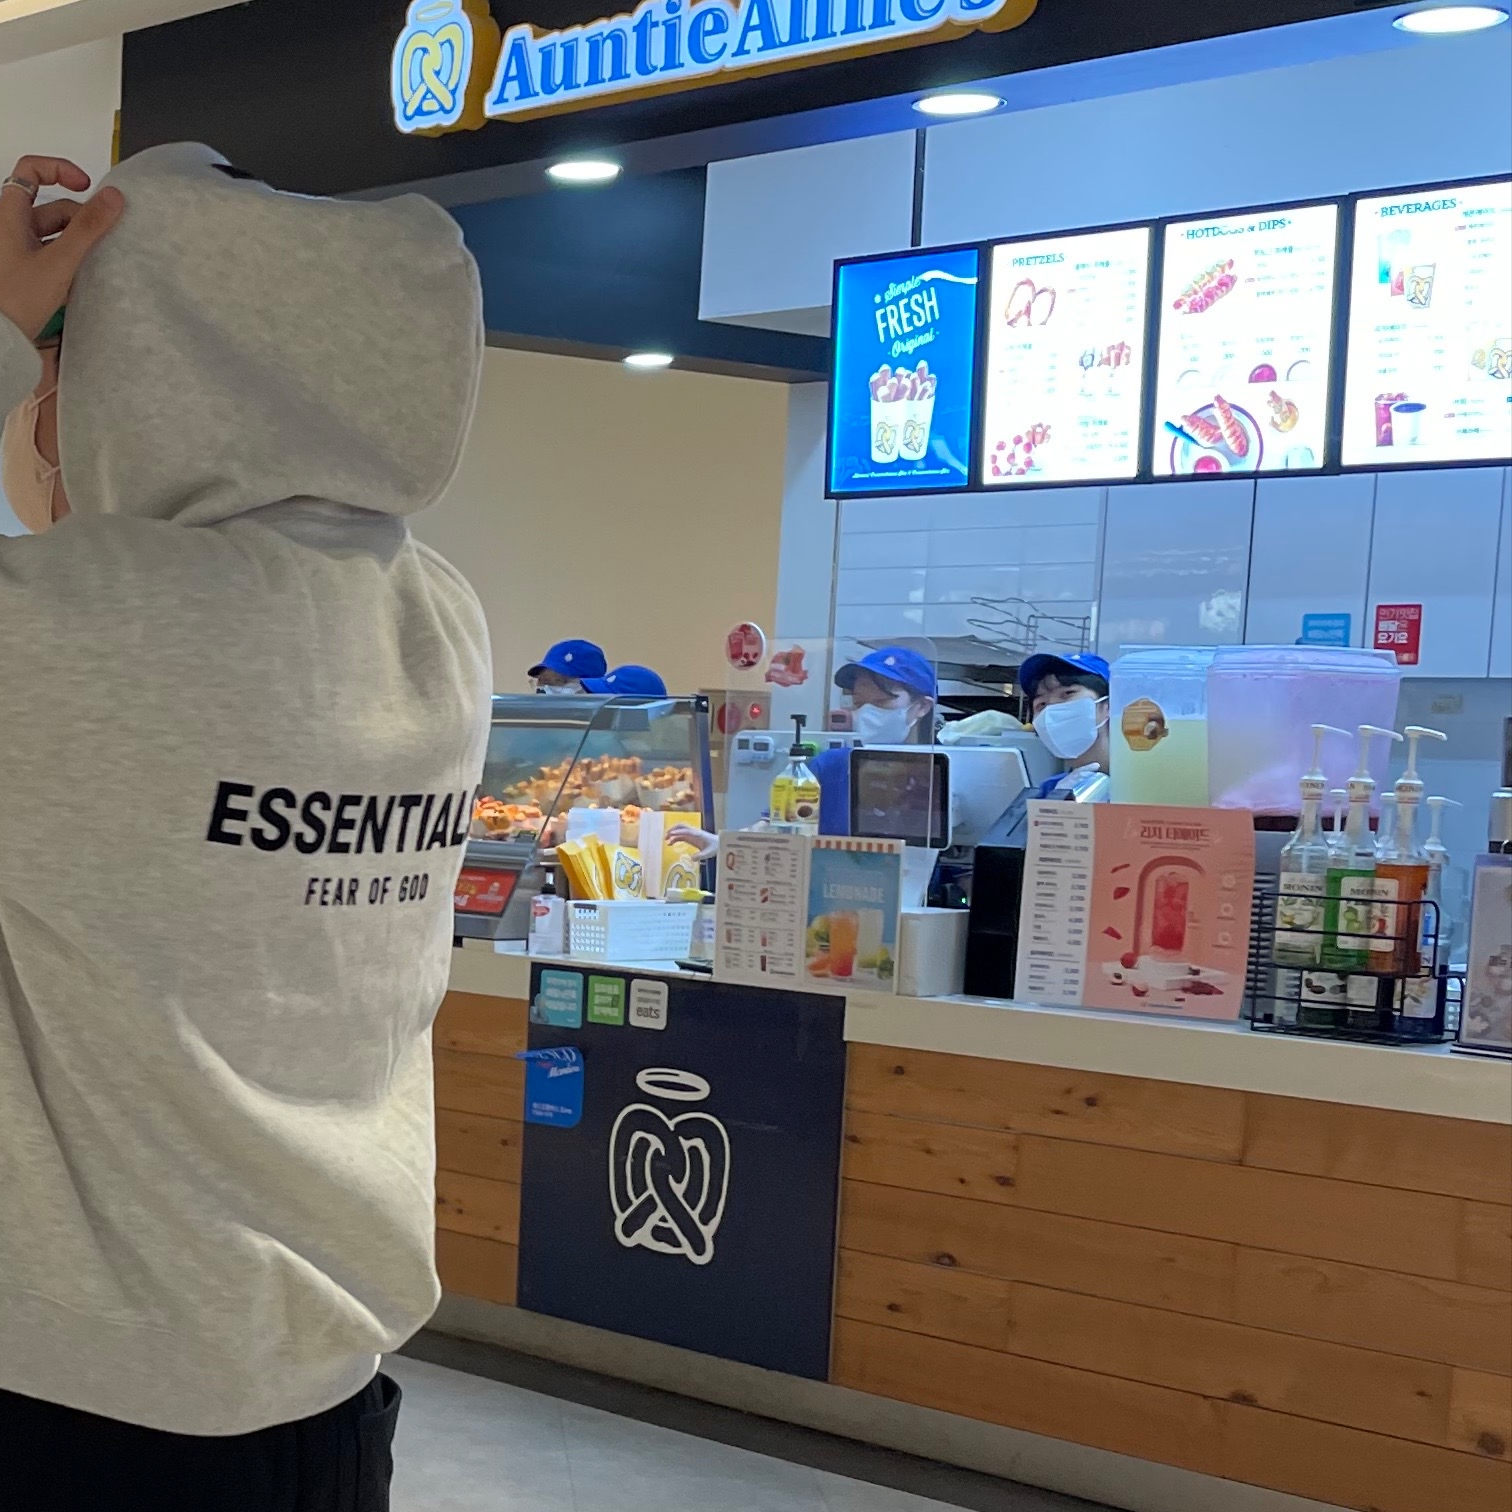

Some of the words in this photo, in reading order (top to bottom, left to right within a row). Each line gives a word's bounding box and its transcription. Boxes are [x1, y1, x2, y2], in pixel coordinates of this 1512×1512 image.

[1380, 199, 1457, 218] BEVERAGES
[1258, 218, 1287, 232] DIPS
[1012, 253, 1065, 267] PRETZELS
[884, 275, 921, 303] Simple
[875, 286, 940, 343] FRESH
[891, 327, 935, 357] Original
[1377, 632, 1408, 644] 요기요
[206, 780, 482, 855] ESSENTIAL
[304, 877, 359, 906] FEAR
[368, 876, 392, 906] OF
[398, 873, 429, 901] GOD
[637, 1006, 660, 1019] eats
